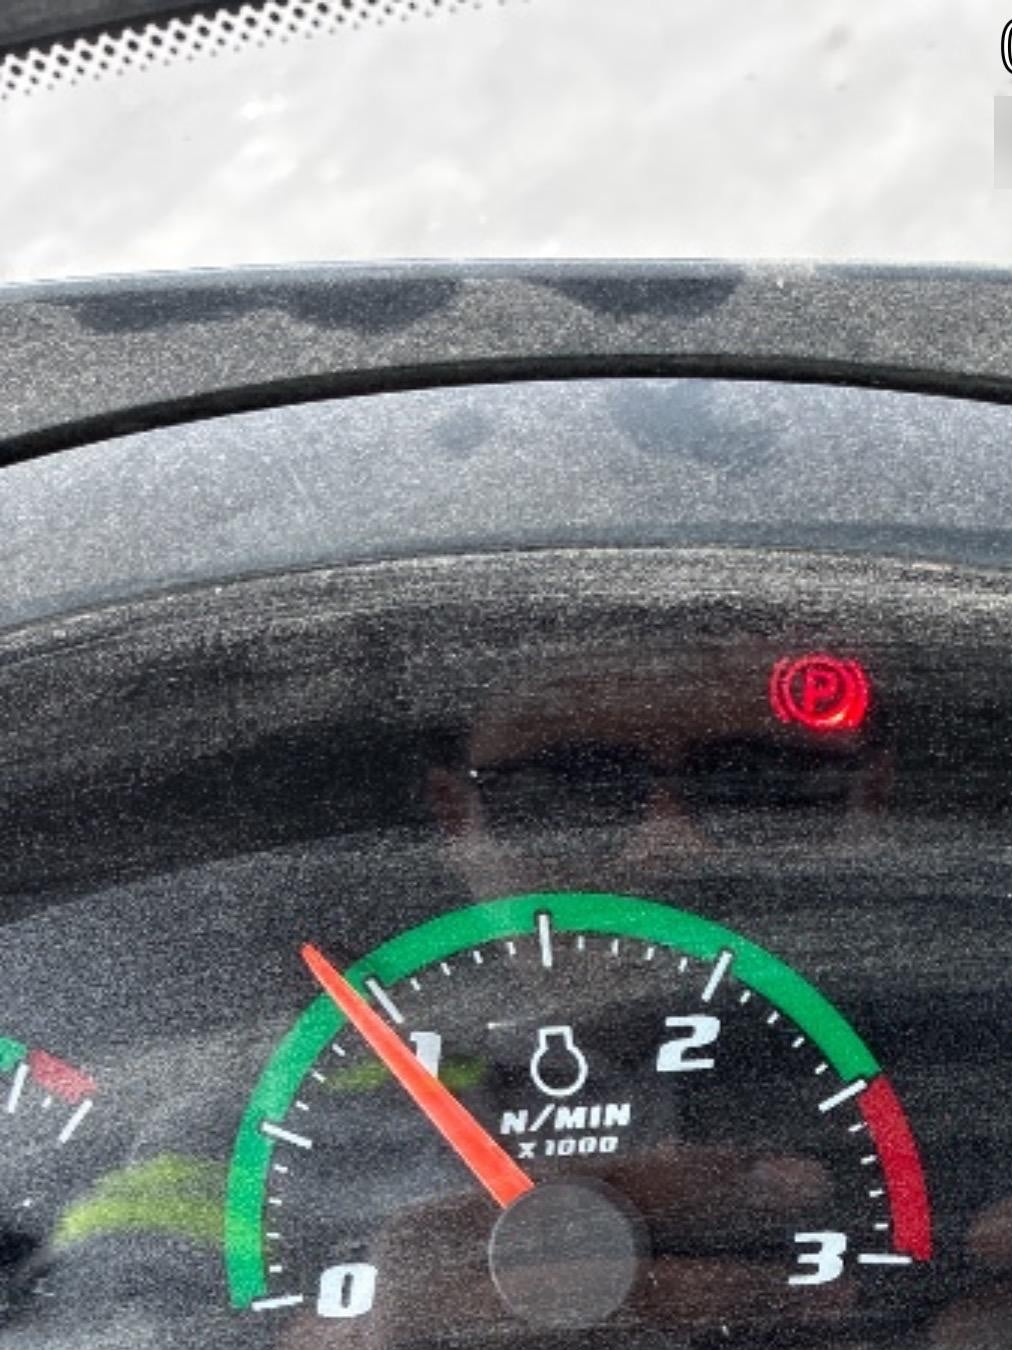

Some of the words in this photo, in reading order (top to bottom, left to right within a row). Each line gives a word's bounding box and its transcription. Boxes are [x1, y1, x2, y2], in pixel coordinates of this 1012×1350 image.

[656, 1015, 721, 1073] 2
[500, 1102, 631, 1134] N/MIN
[545, 1136, 619, 1156] 1000
[788, 1232, 848, 1286] 3
[316, 1263, 378, 1318] 0
